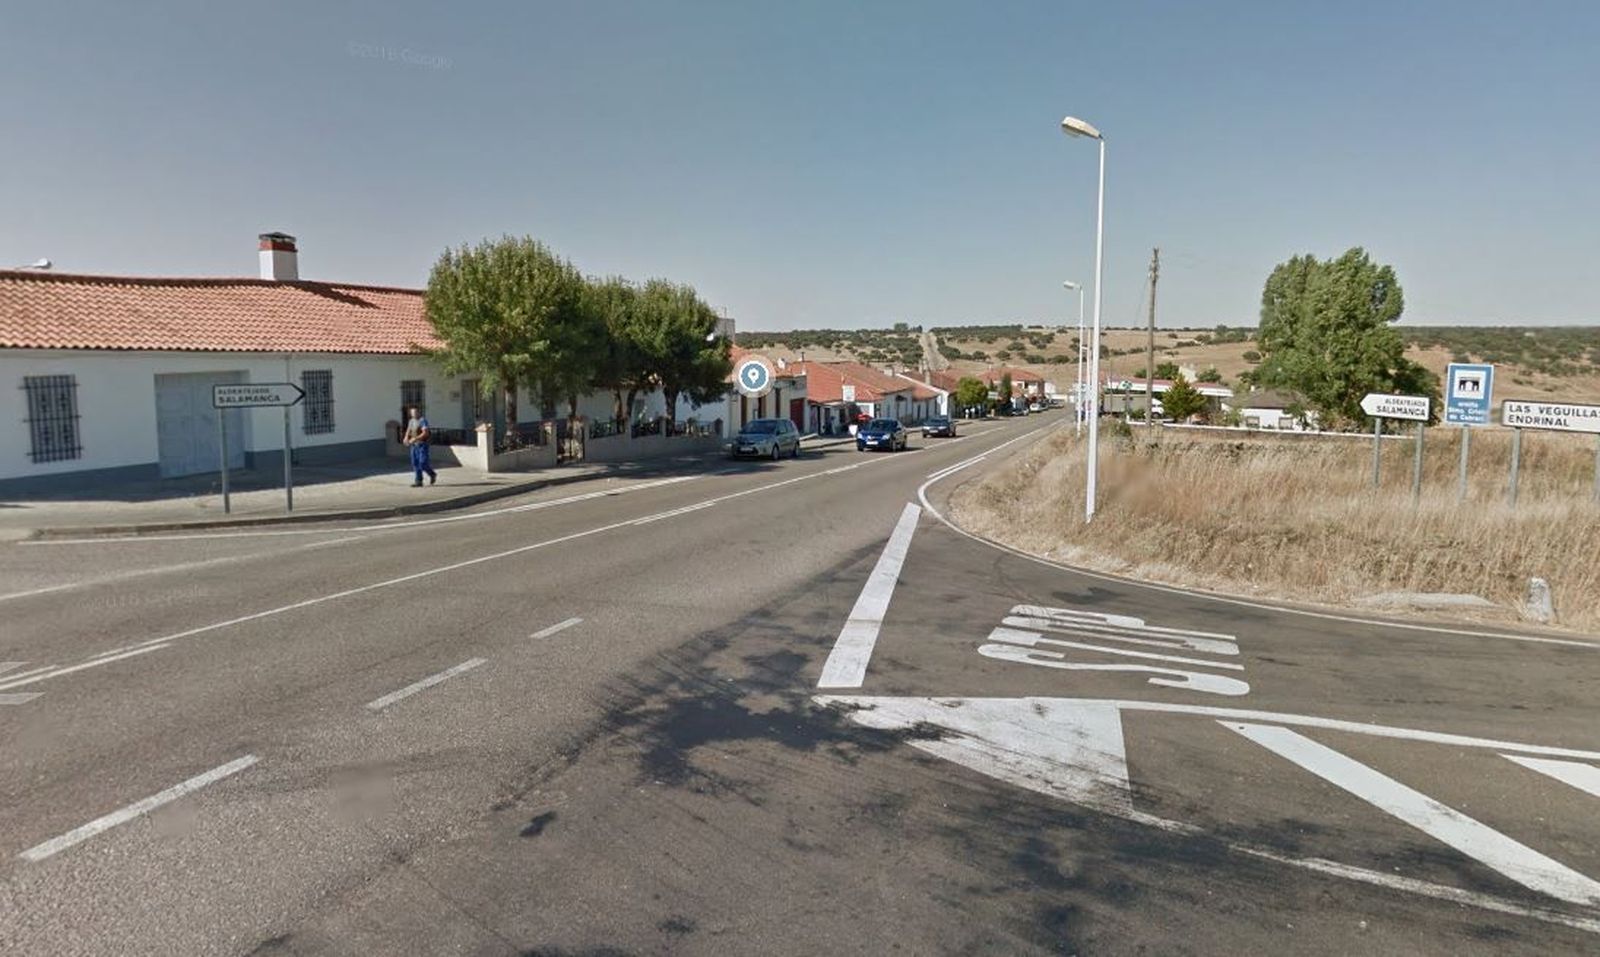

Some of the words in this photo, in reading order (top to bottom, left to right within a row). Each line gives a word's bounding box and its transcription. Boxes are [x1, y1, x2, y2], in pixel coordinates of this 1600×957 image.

[218, 395, 281, 403] SALAMANCA
[1376, 405, 1426, 417] SALAMANCA
[1509, 405, 1531, 413] LAS
[1538, 406, 1600, 418] VEGUILLA
[1508, 414, 1569, 427] ENDRINAL
